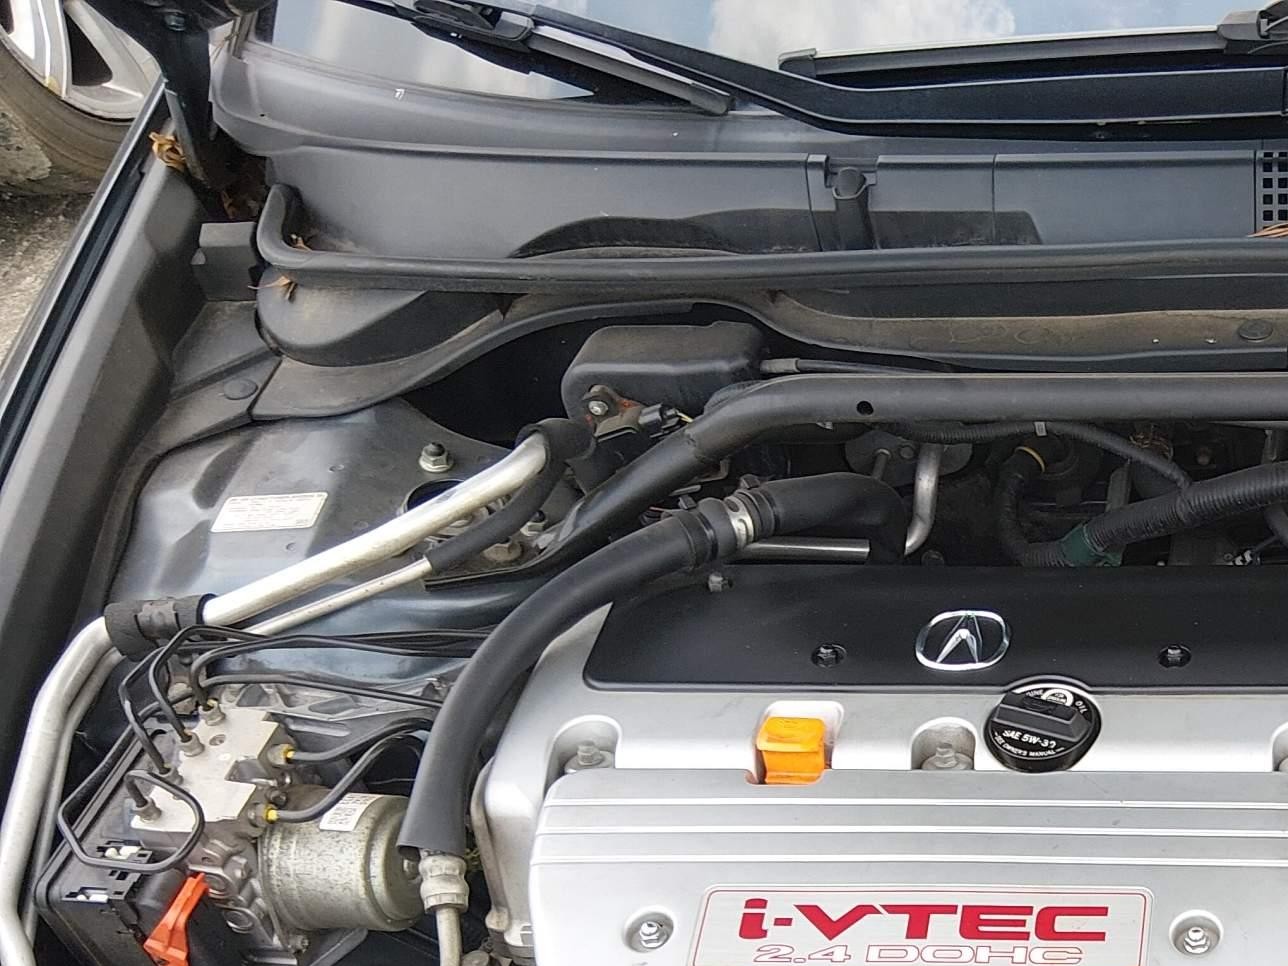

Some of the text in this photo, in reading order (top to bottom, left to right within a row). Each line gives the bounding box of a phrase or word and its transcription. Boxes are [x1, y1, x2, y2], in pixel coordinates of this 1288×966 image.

[1075, 700, 1088, 714] OIL
[1002, 729, 1022, 741] SAE
[1028, 749, 1056, 757] MANUAL
[738, 897, 1109, 942] i-VTEC
[752, 944, 1084, 965] 2.4 DOHC
